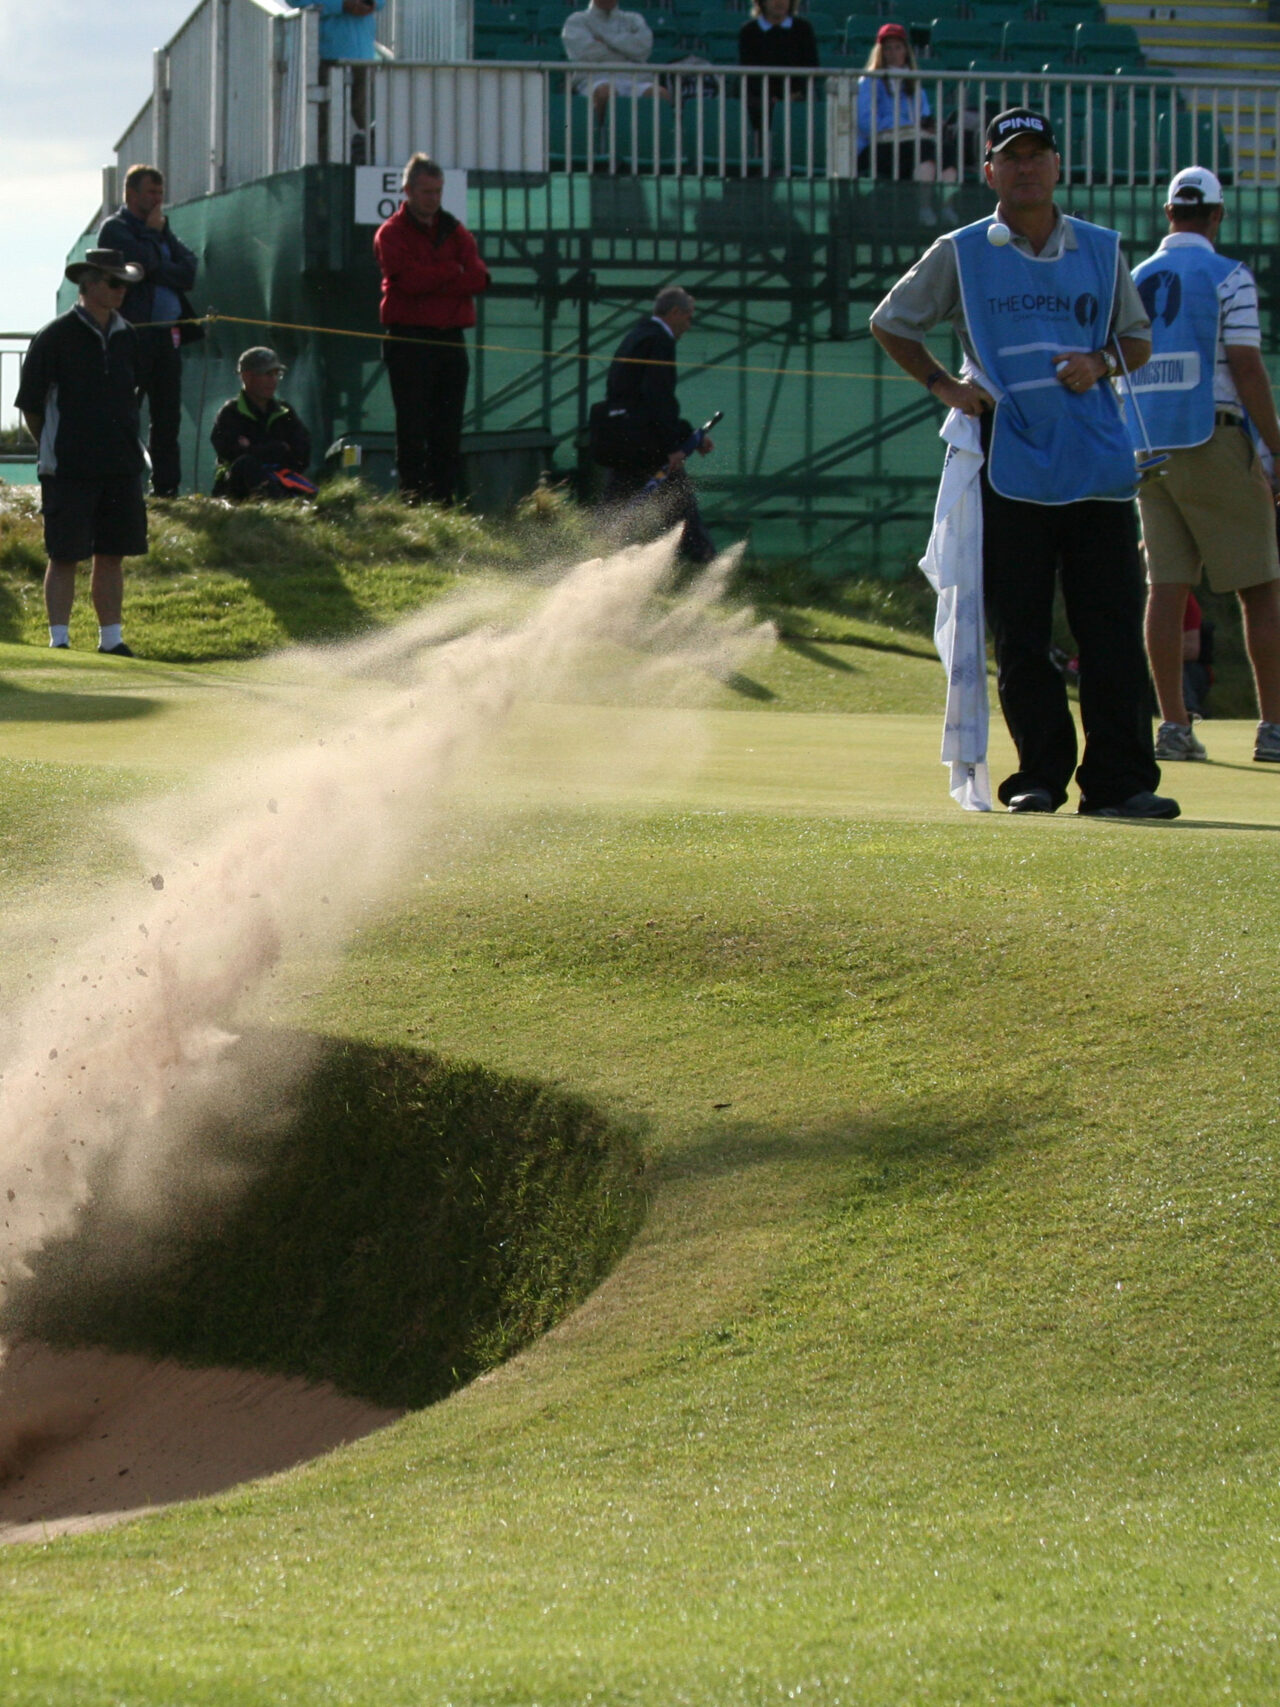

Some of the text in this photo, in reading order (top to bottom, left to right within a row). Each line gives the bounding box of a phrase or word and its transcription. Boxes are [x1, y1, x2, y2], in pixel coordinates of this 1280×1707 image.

[998, 117, 1044, 135] PING
[986, 294, 1071, 316] THE OPEN
